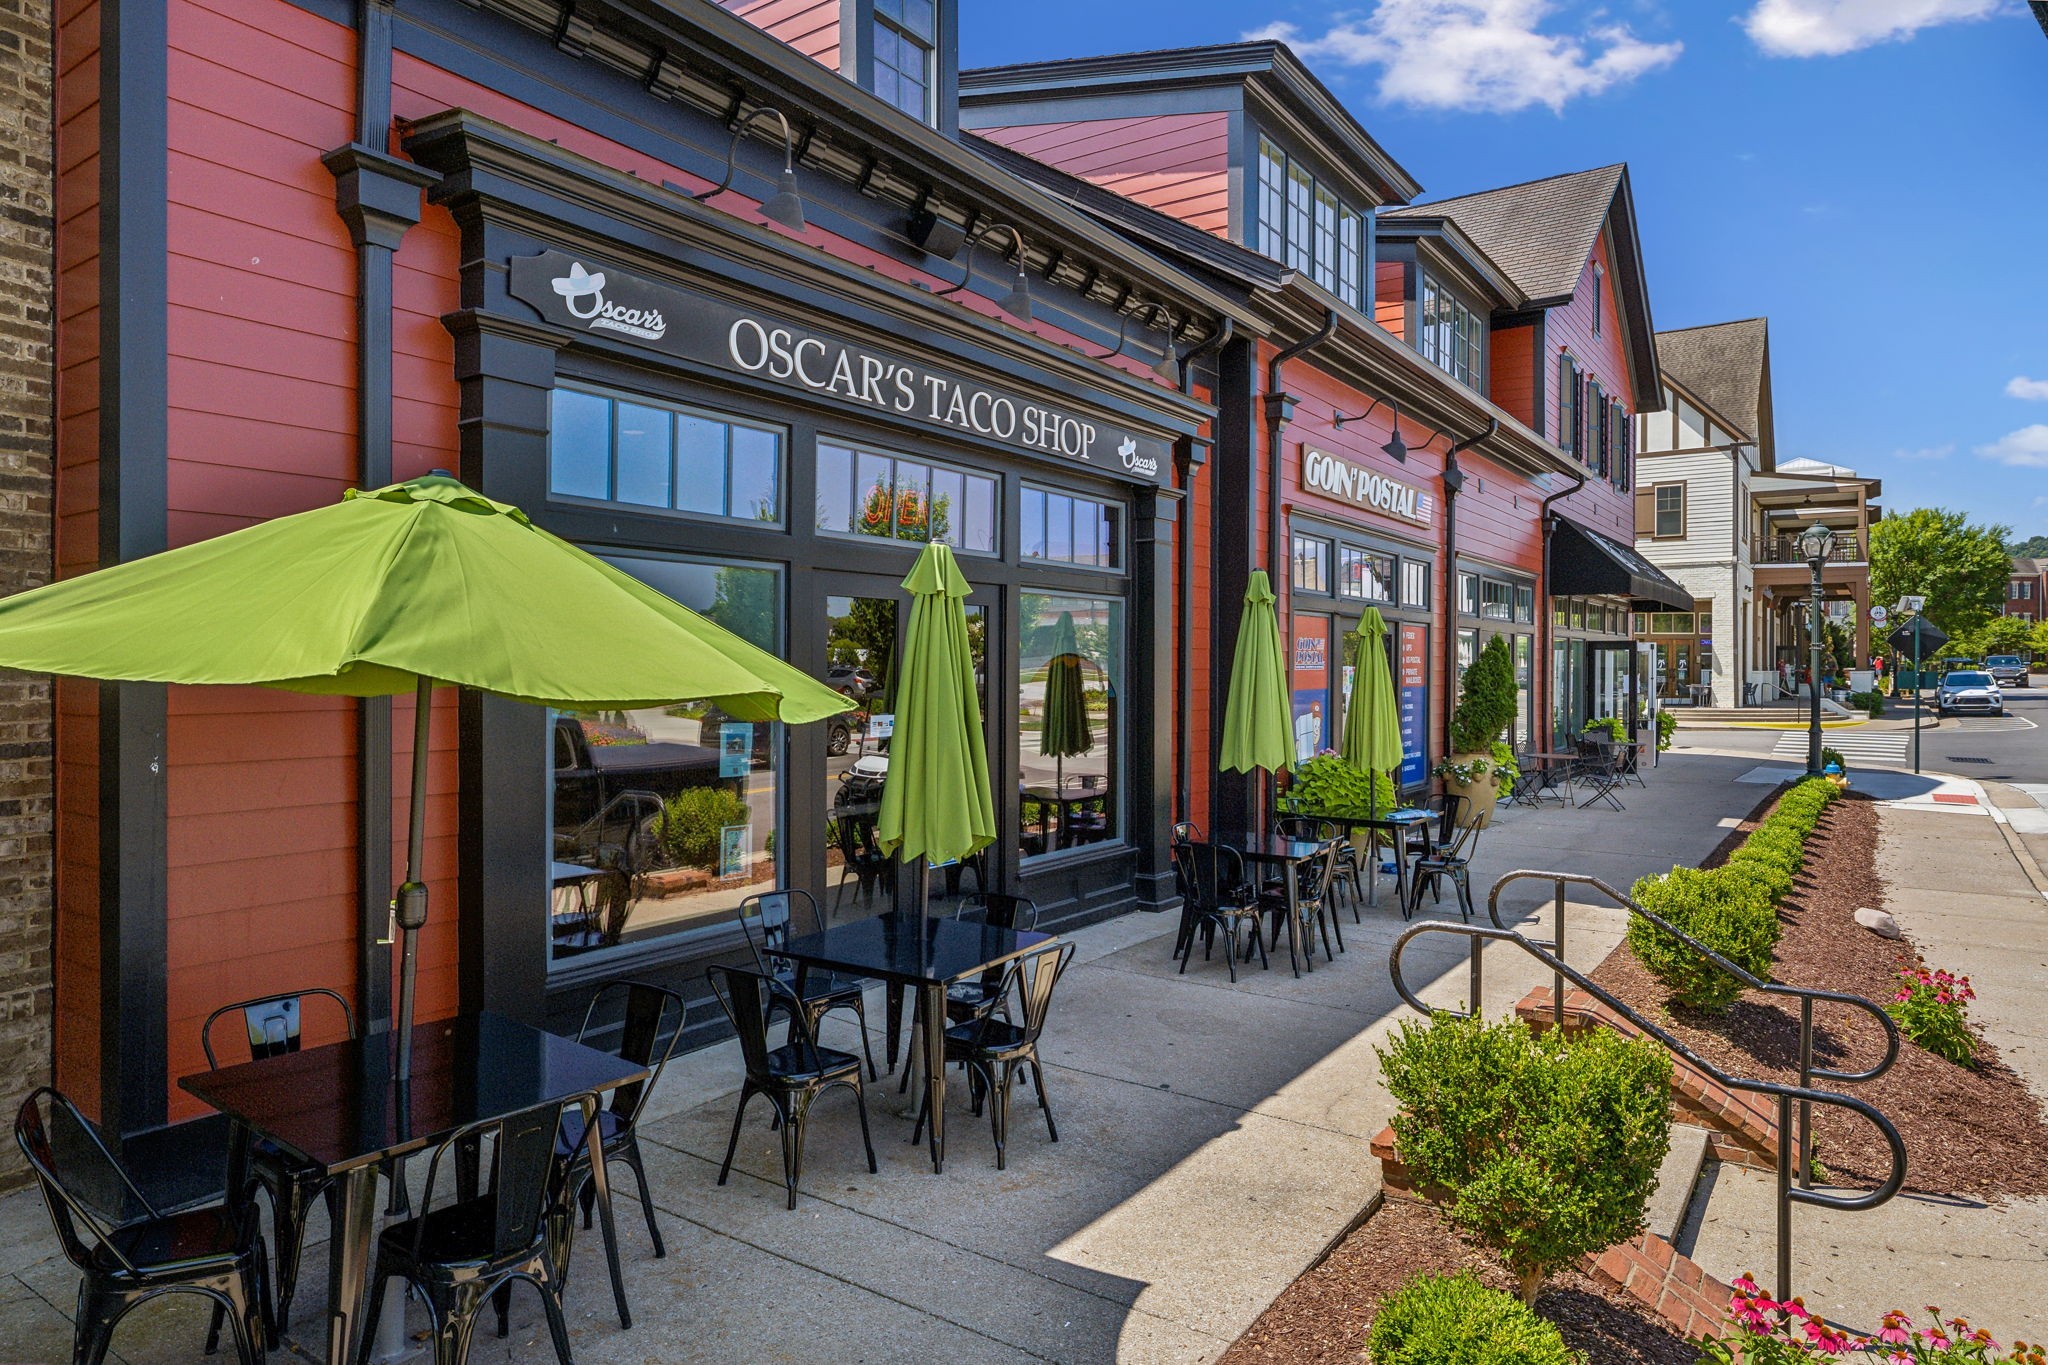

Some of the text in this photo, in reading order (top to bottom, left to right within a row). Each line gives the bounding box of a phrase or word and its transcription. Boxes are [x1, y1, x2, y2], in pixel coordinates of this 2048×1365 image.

[563, 284, 667, 332] Oscar's
[728, 318, 1097, 460] OSCAR'S TACO SHOP
[1305, 451, 1416, 519] GOIN' POSTAL
